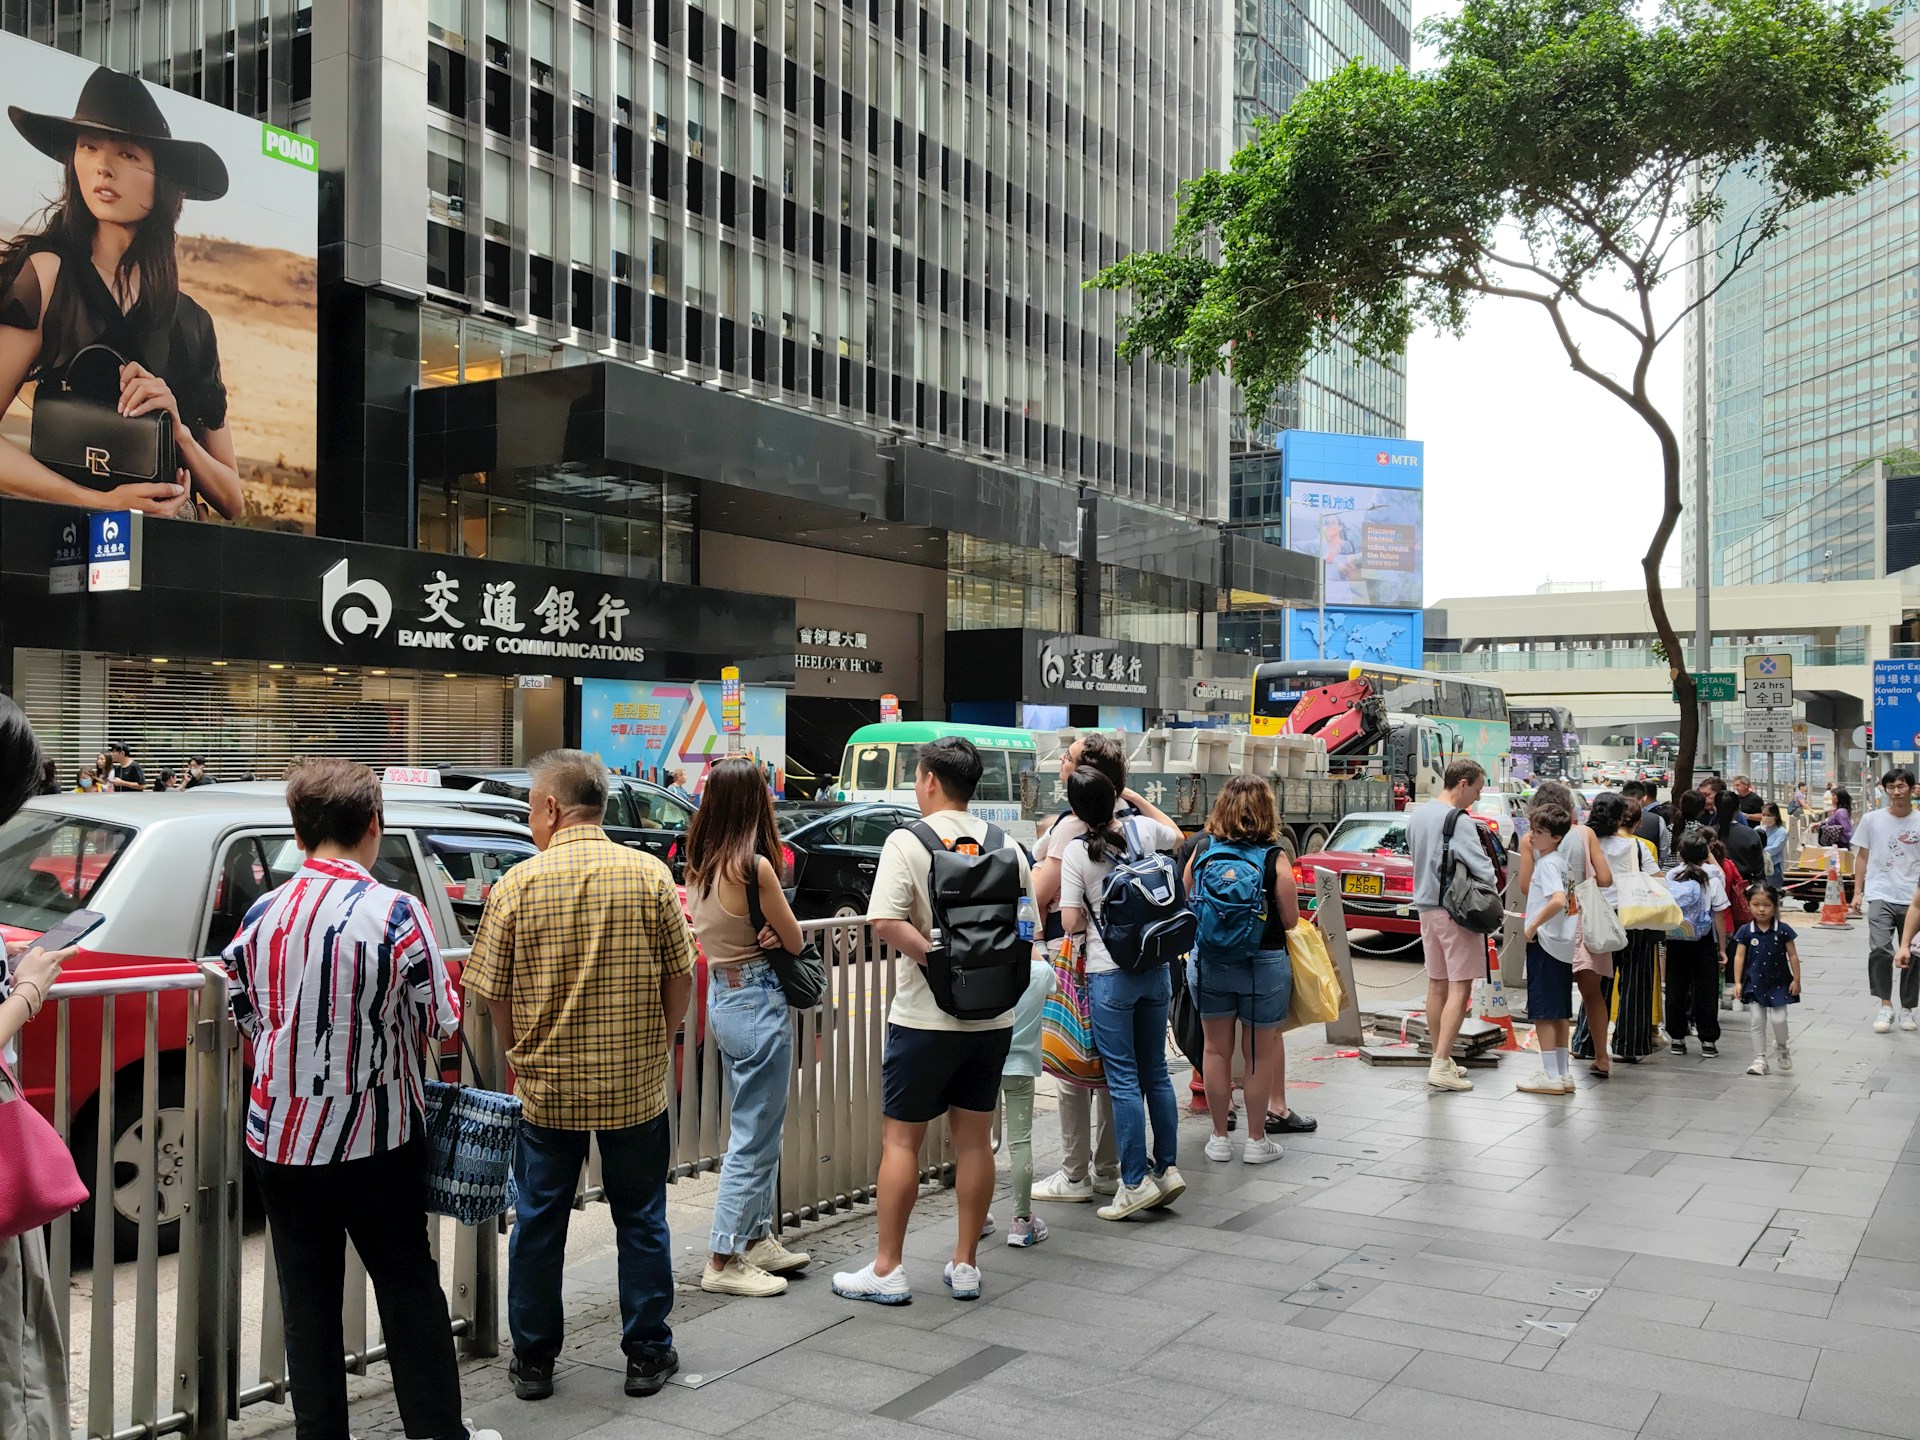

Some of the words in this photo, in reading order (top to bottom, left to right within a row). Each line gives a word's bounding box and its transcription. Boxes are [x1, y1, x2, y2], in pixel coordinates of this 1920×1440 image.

[266, 130, 314, 165] POAD
[1391, 454, 1418, 466] MTR
[1367, 527, 1396, 536] Discover
[418, 570, 630, 642] 交通銀行
[799, 627, 868, 649] 會德豐大廈
[398, 629, 455, 650] BANK
[462, 633, 489, 651] OF
[495, 636, 645, 663] COMMUNICATIONS
[1071, 649, 1143, 683] 交通銀行
[1875, 663, 1905, 672] Airport
[1907, 663, 1920, 671] Ex
[521, 676, 543, 689] Jetco
[1065, 679, 1084, 690] BANK
[1085, 681, 1095, 691] OF
[1096, 683, 1148, 695] COMMUNICATIONS
[1753, 682, 1766, 690] 24
[1768, 681, 1785, 689] hrs
[1757, 692, 1783, 704] 全日
[1875, 696, 1899, 706] 九龍
[645, 738, 662, 749] 成立
[974, 737, 993, 745] PUBLIC
[1011, 739, 1023, 747] BUS
[388, 769, 429, 783] TAXI
[1356, 875, 1371, 884] KP
[1349, 883, 1377, 894] 7585
